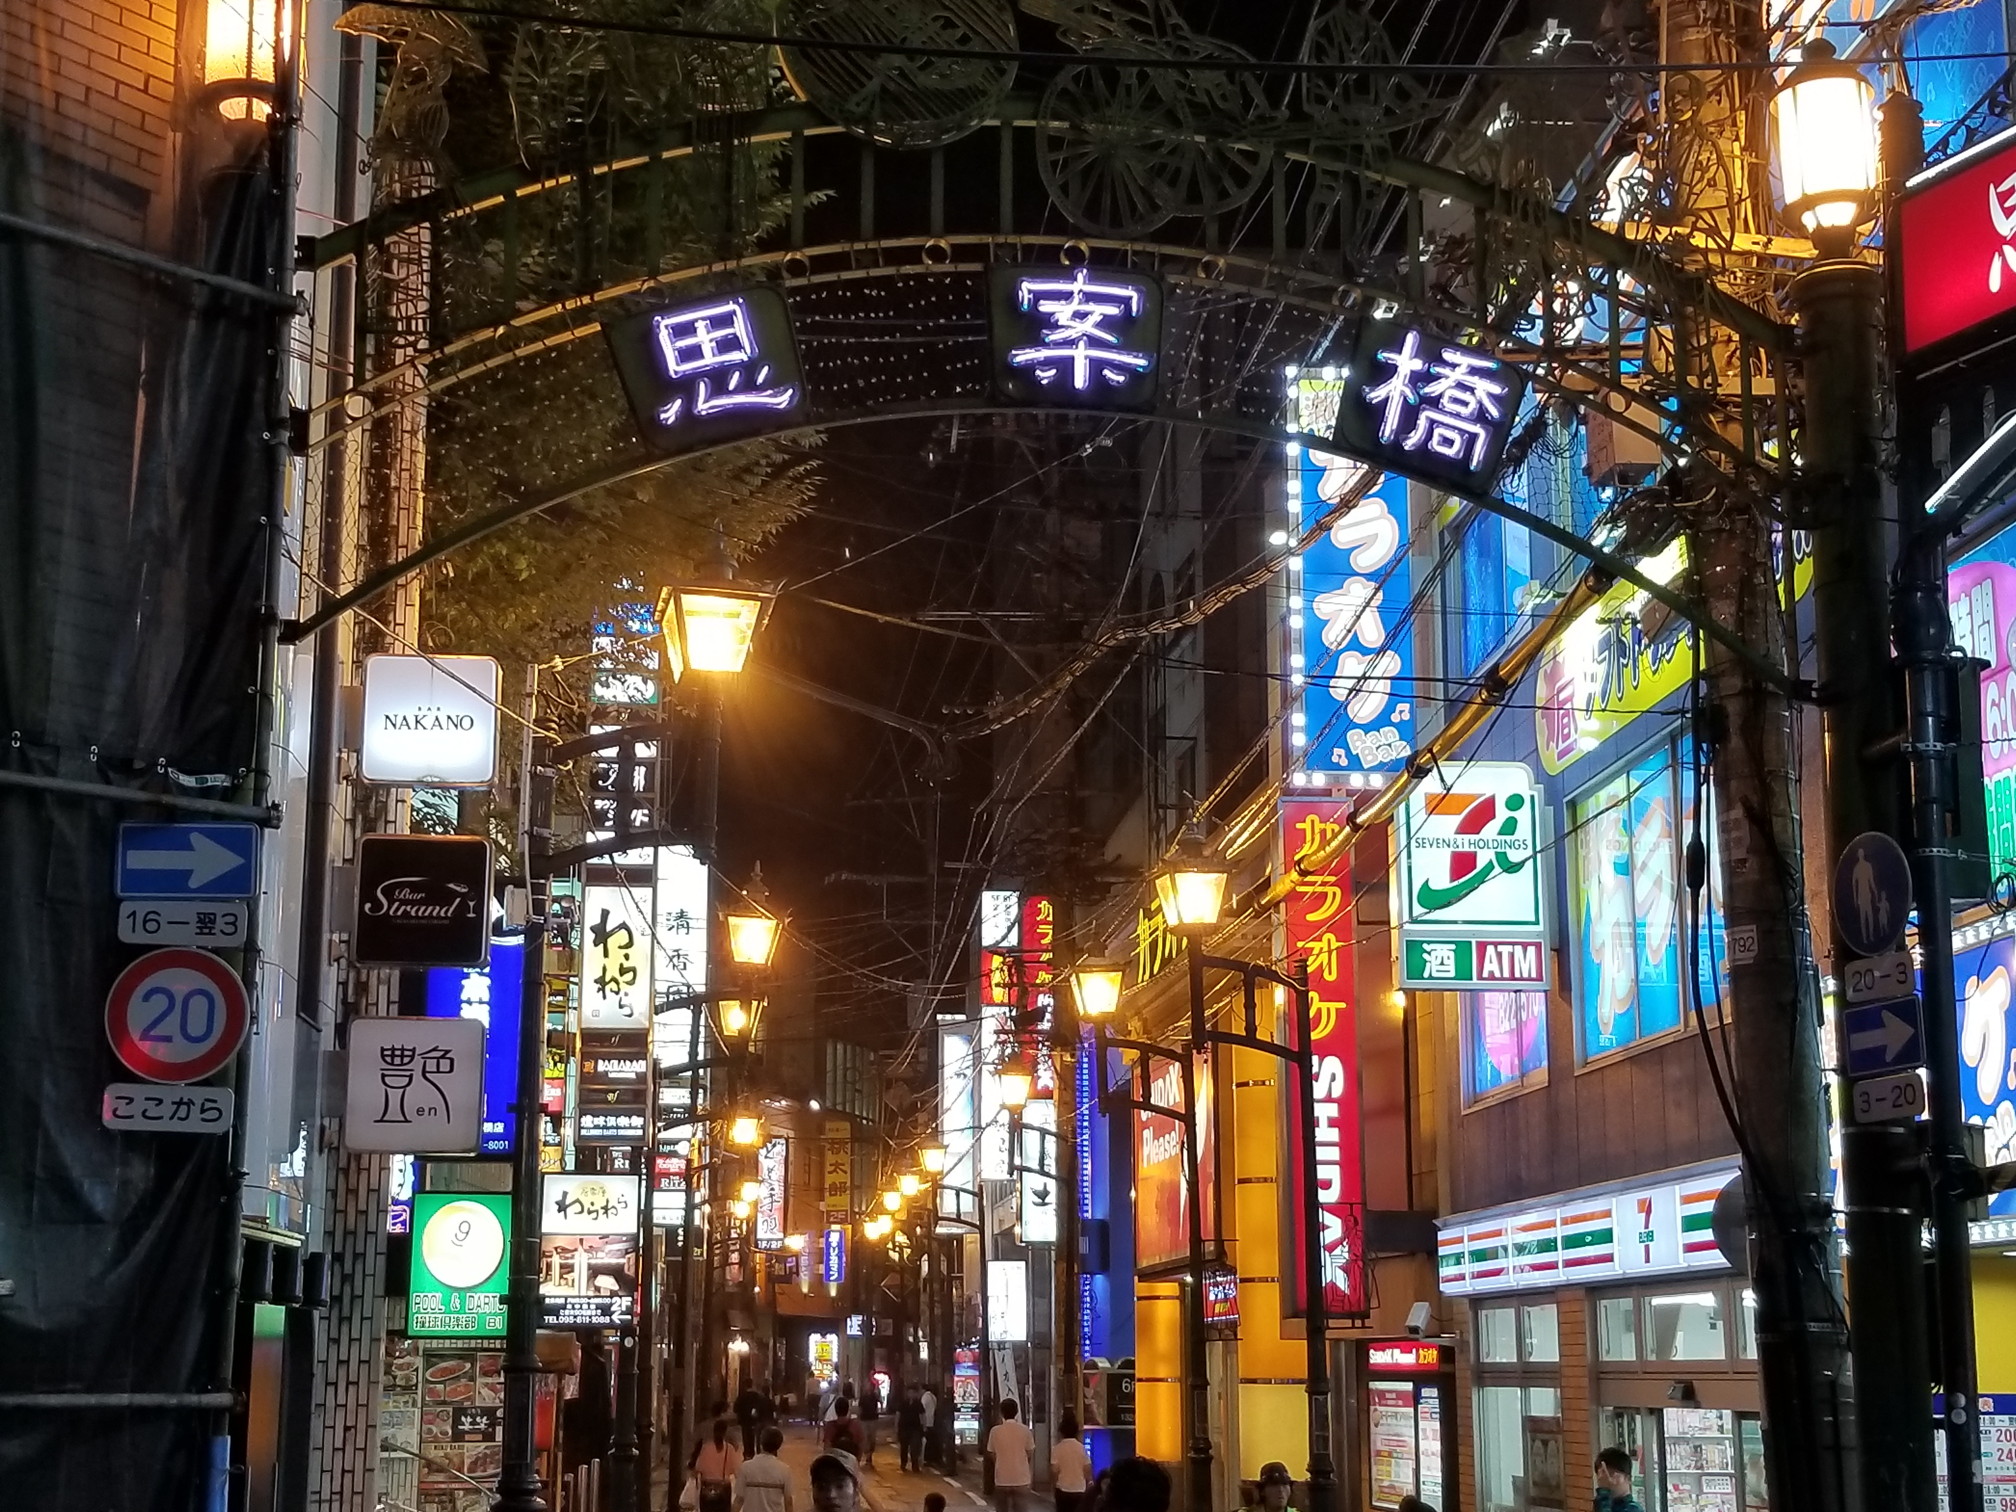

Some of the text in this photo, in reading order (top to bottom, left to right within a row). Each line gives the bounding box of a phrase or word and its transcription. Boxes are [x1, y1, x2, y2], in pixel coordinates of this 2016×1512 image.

[384, 714, 474, 731] NAKANO
[1415, 837, 1450, 850] SEVEN
[1452, 839, 1460, 850] &
[1468, 838, 1528, 851] HOLDINGS
[364, 877, 461, 917] Strand
[394, 888, 425, 899] Bar
[1295, 813, 1346, 1040] カラオケ
[1421, 942, 1456, 979] 酒
[1482, 944, 1537, 979] ATM
[1851, 962, 1908, 993] 20-3
[138, 986, 217, 1044] 20
[111, 1095, 224, 1123] ここから
[416, 1107, 438, 1118] en
[1859, 1082, 1917, 1114] 3-20
[1142, 1120, 1180, 1168] Please!
[1312, 1054, 1345, 1297] SHIDAX
[555, 1191, 629, 1221] わらわら
[413, 1292, 448, 1312] POOL
[450, 1292, 461, 1312] &
[611, 1296, 632, 1312] 2F
